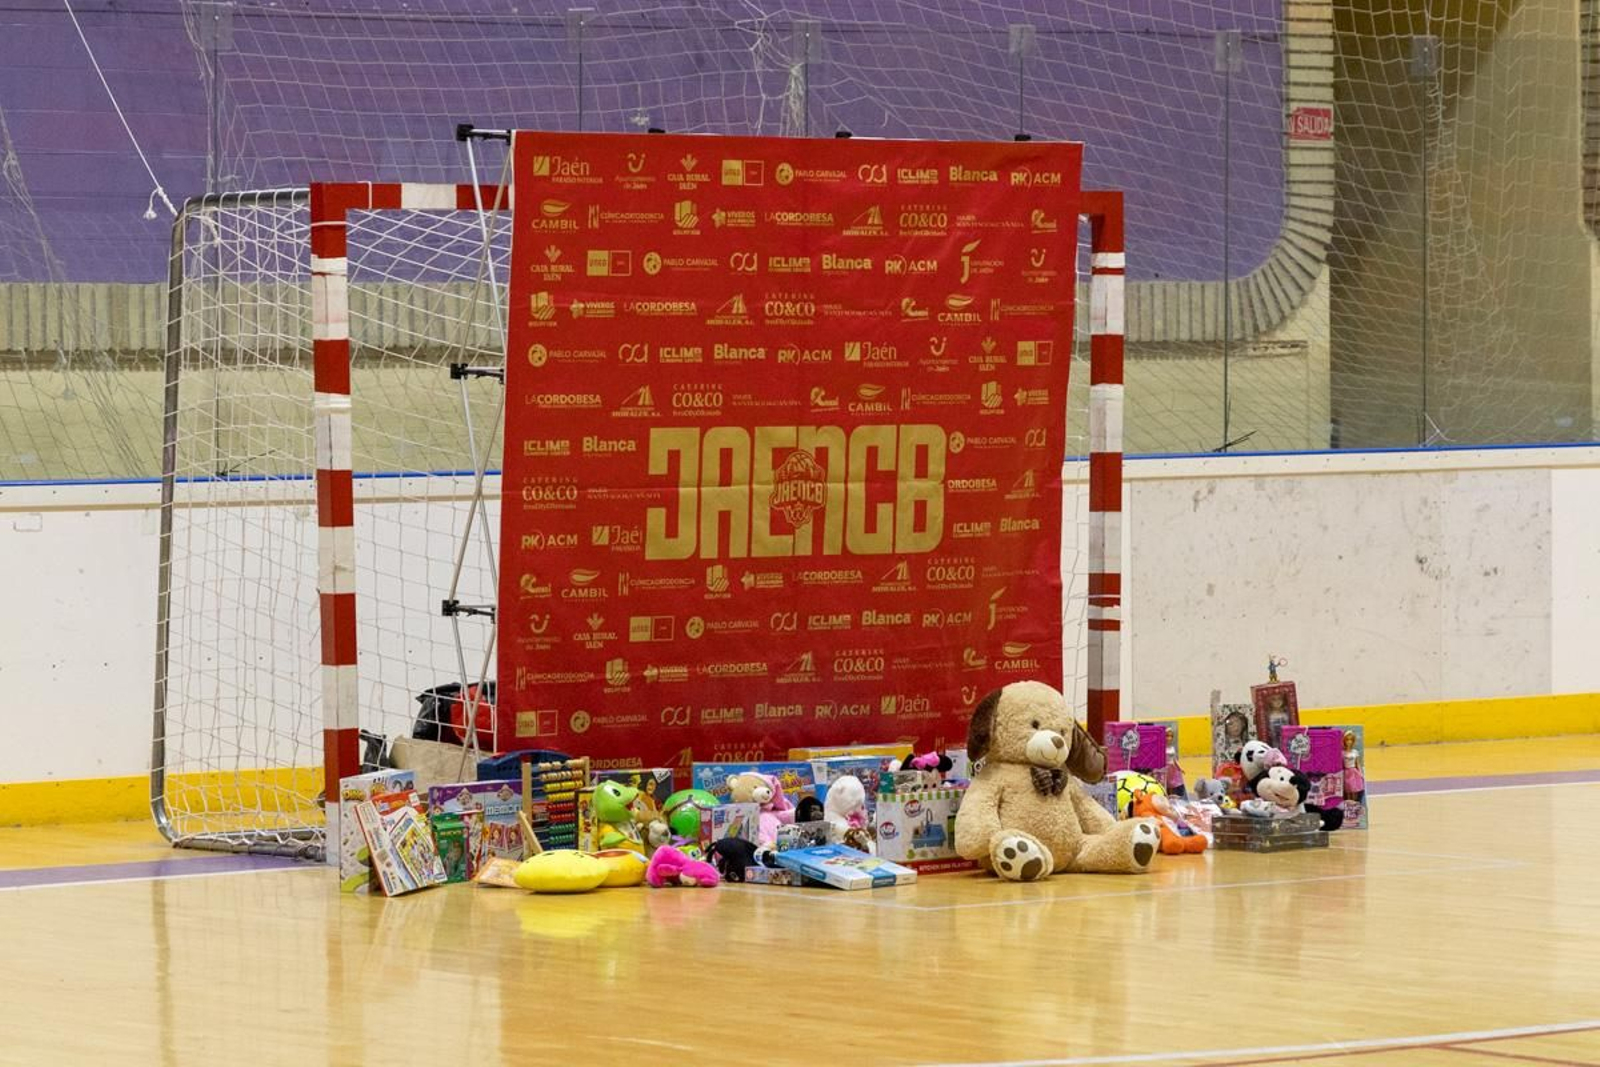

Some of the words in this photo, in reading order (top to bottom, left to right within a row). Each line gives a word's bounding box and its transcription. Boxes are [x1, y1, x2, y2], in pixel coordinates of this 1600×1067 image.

[552, 156, 590, 176] Jaén
[815, 170, 847, 178] CARVAJAL
[949, 166, 998, 182] Blanca
[532, 219, 579, 230] CAMBIL
[900, 212, 948, 227] CO&CO
[663, 258, 684, 266] PABLO
[686, 258, 718, 266] CARVAJAL
[822, 253, 872, 270] Blanca
[765, 301, 815, 317] CO&CO
[937, 312, 982, 323] CAMBIL
[550, 350, 571, 358] PABLO
[573, 350, 607, 359] CARVAJAL
[713, 342, 766, 360] Blanca
[862, 341, 897, 361] Jaén
[672, 392, 723, 407] CO&CO
[848, 402, 892, 412] CAMBIL
[582, 436, 636, 452] Blanca
[522, 485, 577, 501] CO&CO
[1000, 517, 1040, 532] Blanca
[926, 565, 975, 582] CO&CO
[561, 588, 608, 598] CAMBIL
[862, 610, 911, 626] Blanca
[834, 657, 884, 673] CO&CO
[994, 659, 1041, 670] CAMBIL
[755, 702, 803, 719] Blanca
[898, 694, 929, 713] Jaén
[593, 716, 615, 724] PABLO
[616, 714, 648, 723] CARVAJAL
